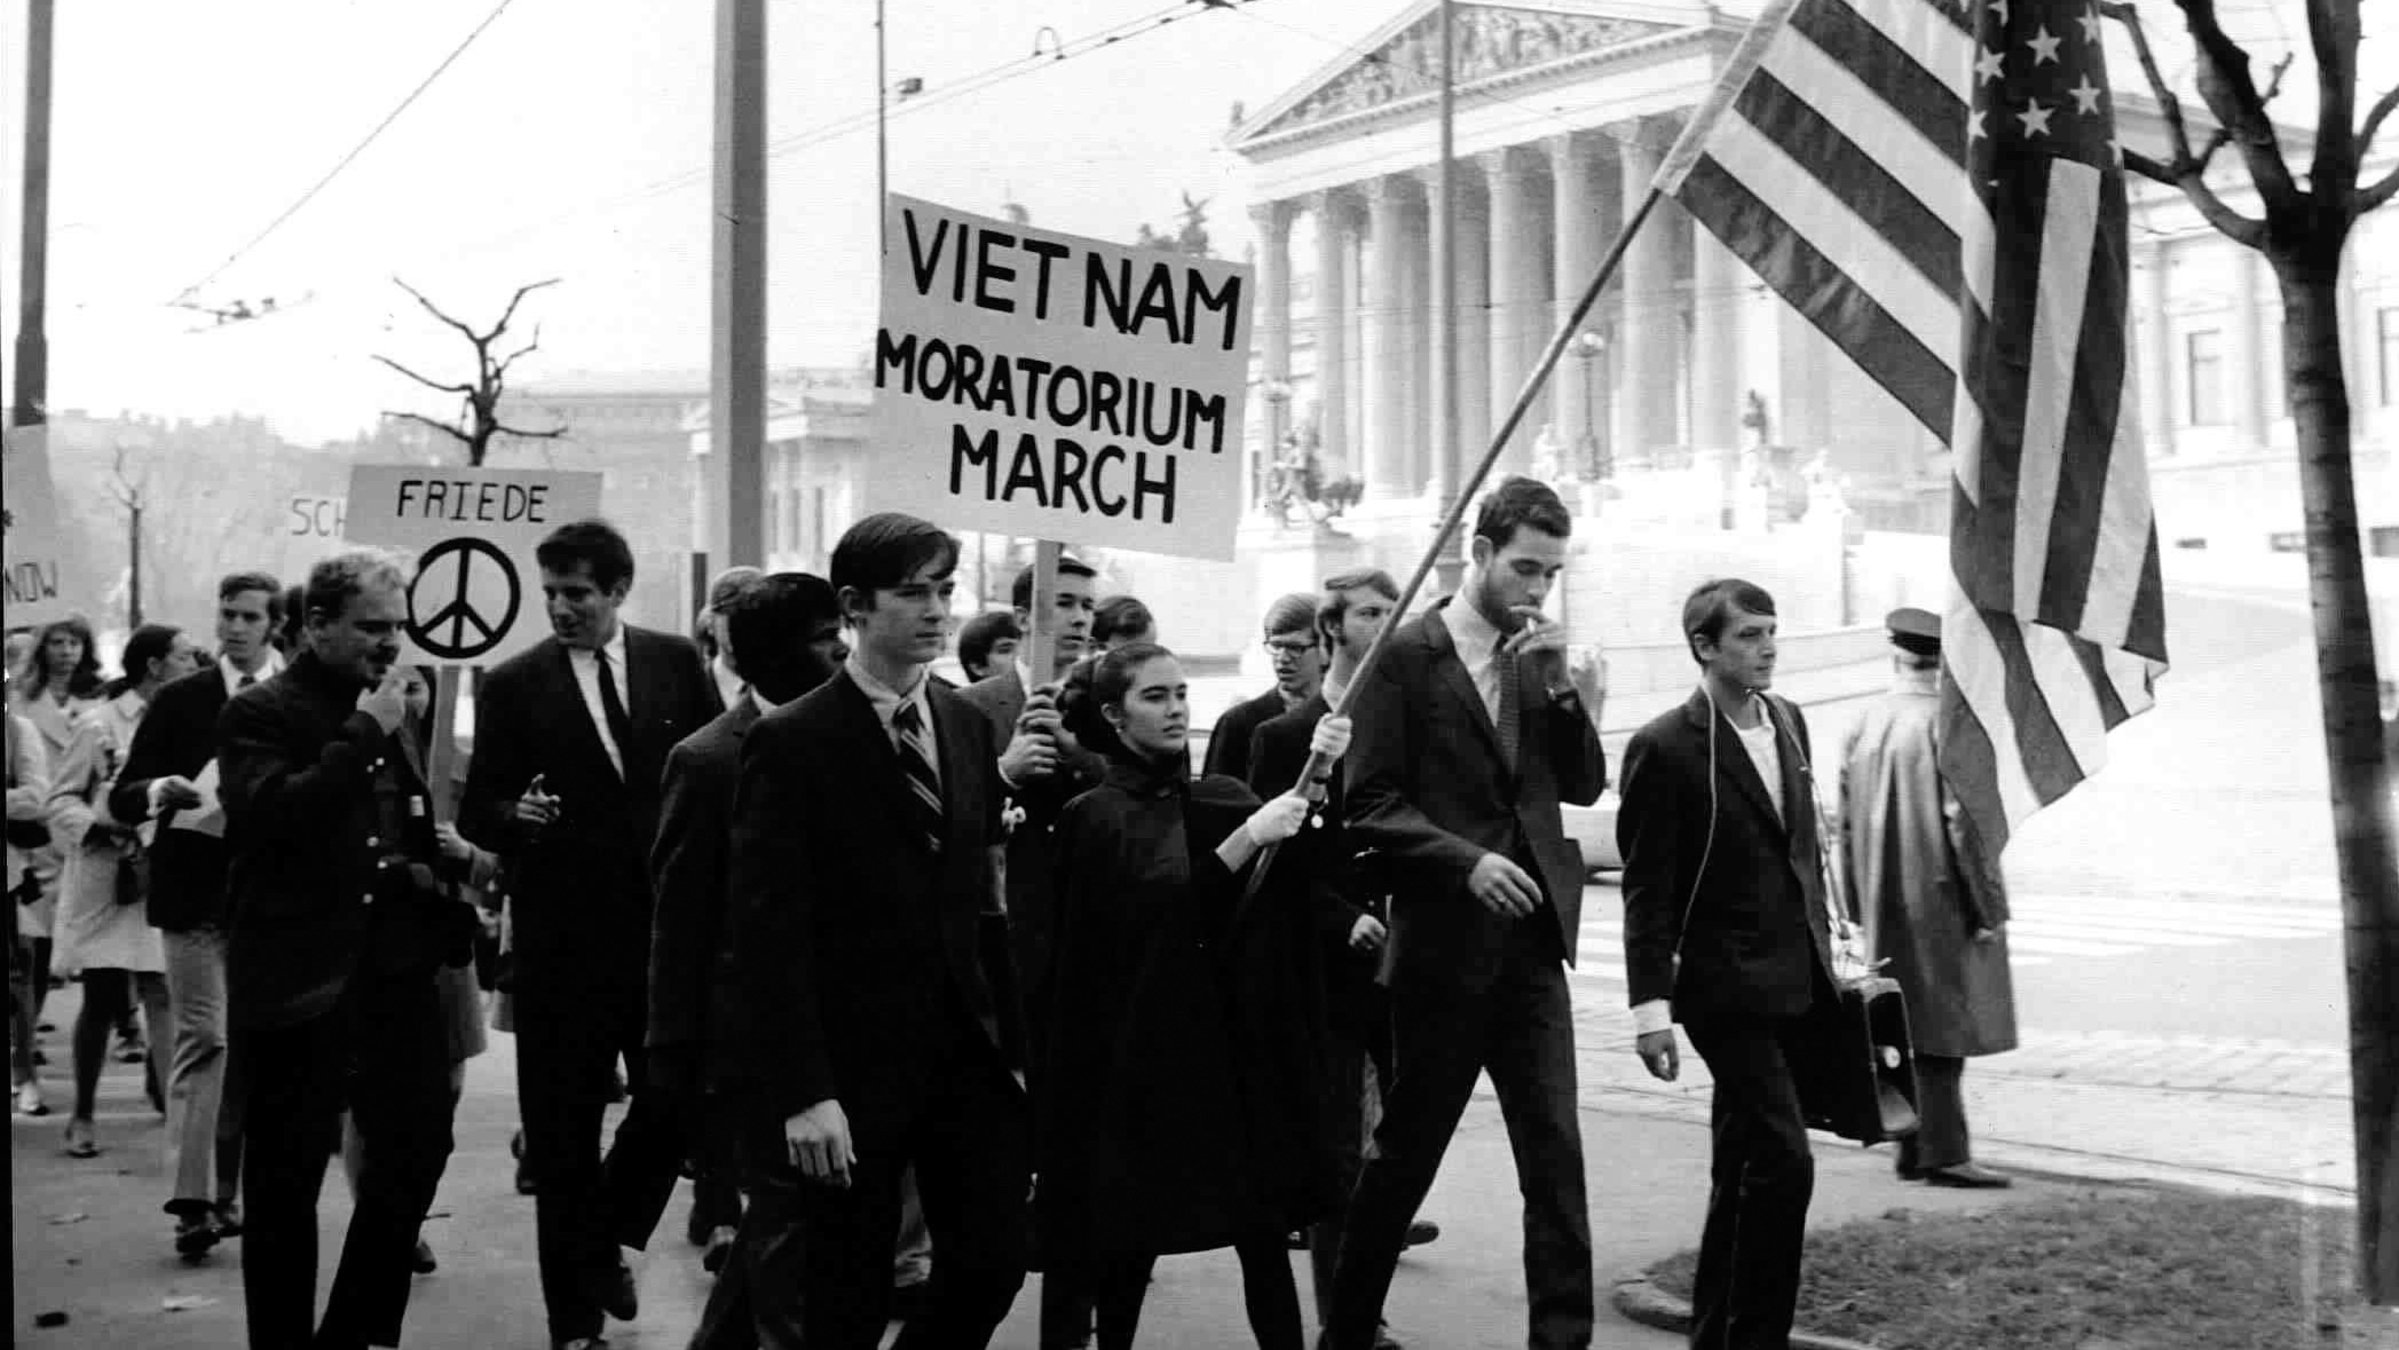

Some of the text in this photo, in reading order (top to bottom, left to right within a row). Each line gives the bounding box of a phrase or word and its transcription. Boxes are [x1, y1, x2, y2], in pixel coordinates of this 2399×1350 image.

[903, 208, 1242, 351] VIET NAM
[875, 328, 1226, 454] MORATORIUM
[397, 480, 549, 523] FRIEDE
[950, 424, 1177, 524] MARCH
